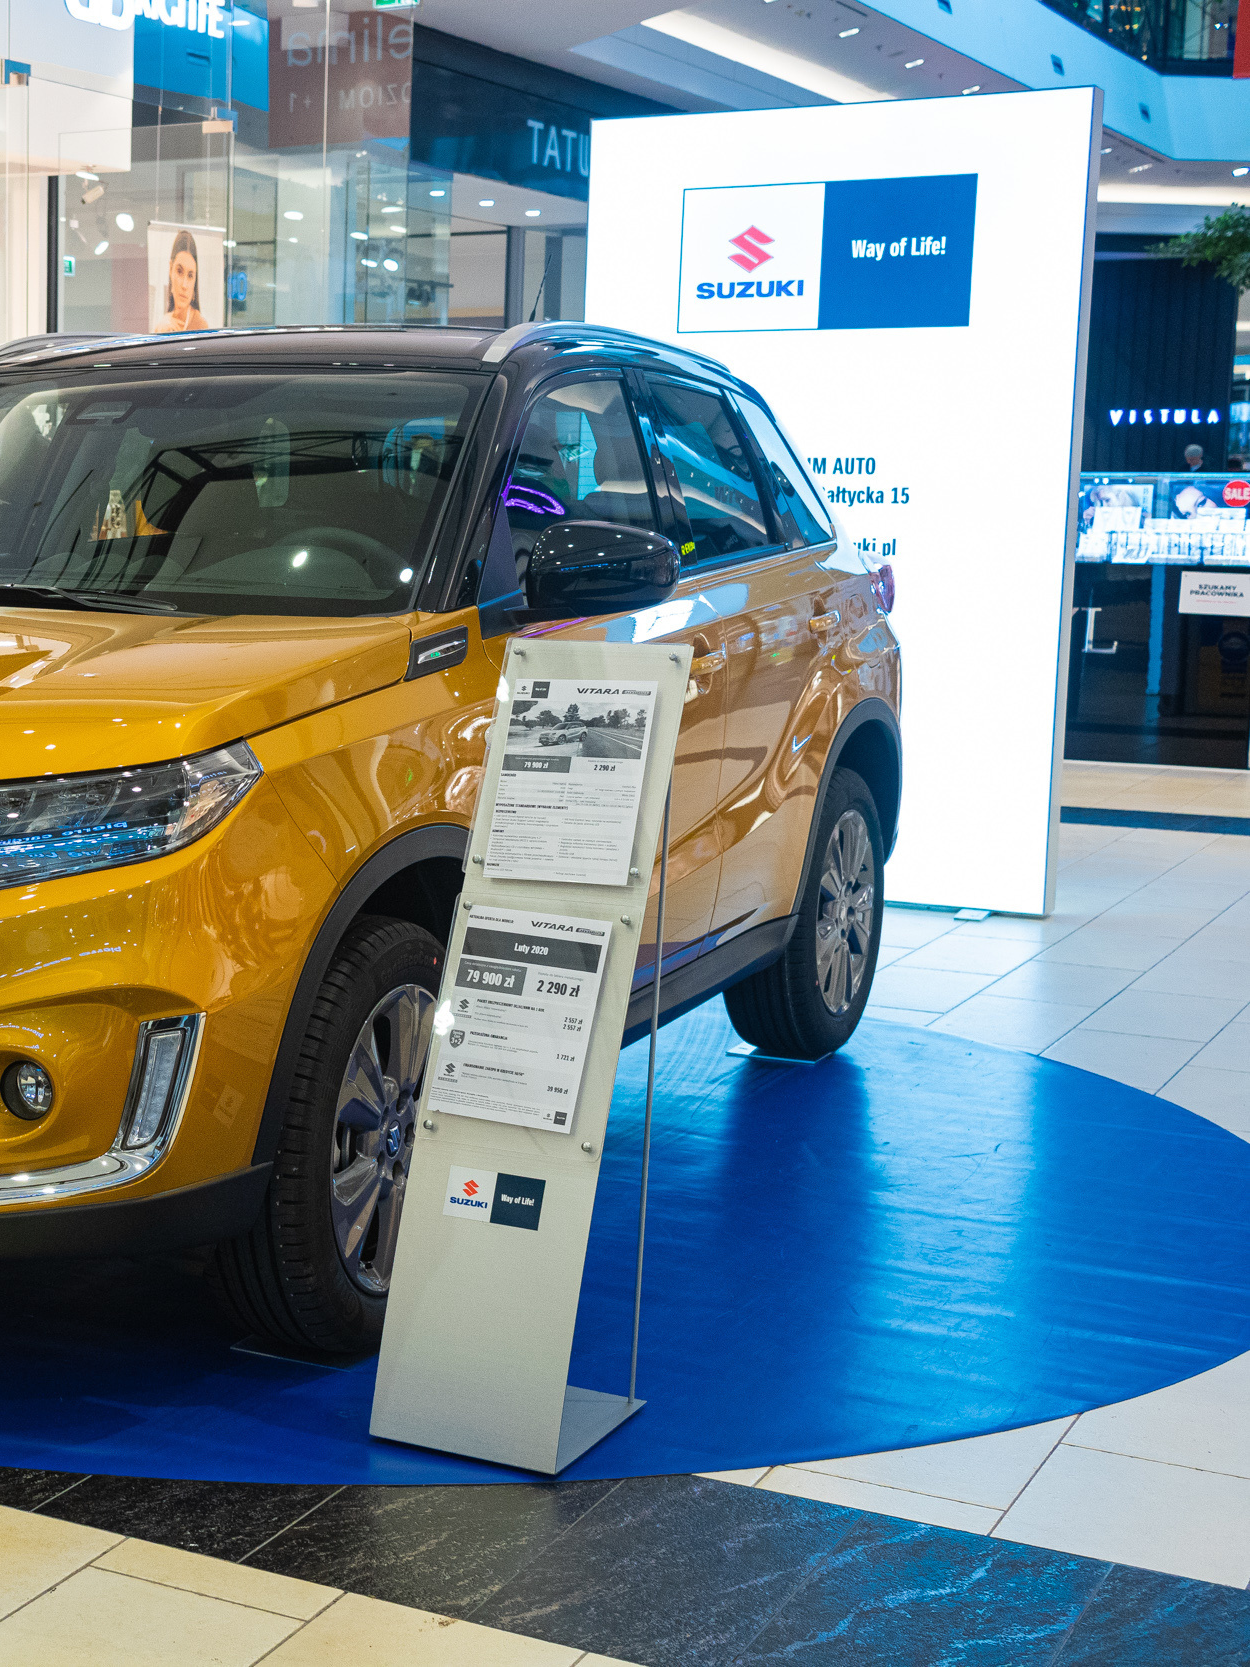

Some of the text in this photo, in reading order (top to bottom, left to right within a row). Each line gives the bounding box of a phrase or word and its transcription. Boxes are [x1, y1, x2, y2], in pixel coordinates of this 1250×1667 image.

[851, 236, 946, 261] Way of Life!
[696, 280, 804, 299] SUZUKI
[1110, 409, 1219, 426] VISTULA
[832, 457, 876, 475] AUTO
[823, 486, 910, 507] ałtycka 15
[1225, 487, 1250, 501] SALE
[1190, 590, 1245, 598] PRACOWNIKA
[577, 687, 620, 695] VITARA
[599, 764, 610, 772] 290
[531, 920, 574, 932] VITARA
[514, 943, 549, 956] Luty 2020
[466, 969, 516, 988] 79 900 zł
[537, 980, 580, 997] 2 290 zł
[450, 1196, 488, 1209] SUZUKI
[501, 1194, 535, 1206] Way of Life!
